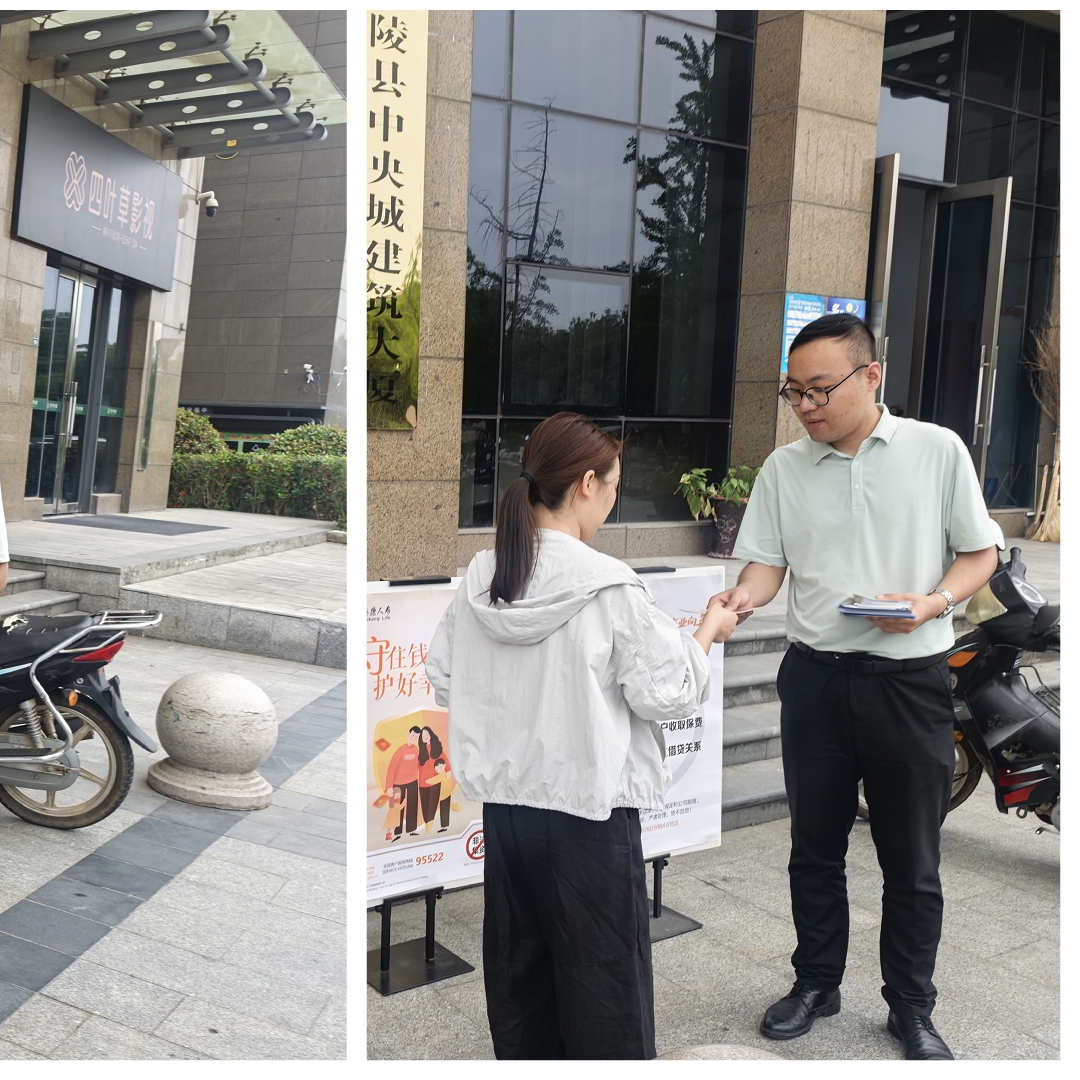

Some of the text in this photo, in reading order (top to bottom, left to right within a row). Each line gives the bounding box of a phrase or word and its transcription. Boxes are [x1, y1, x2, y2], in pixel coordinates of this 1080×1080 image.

[88, 170, 156, 241] 四叶草影视
[665, 741, 702, 758] 借贷关系
[416, 852, 444, 866] 95522
